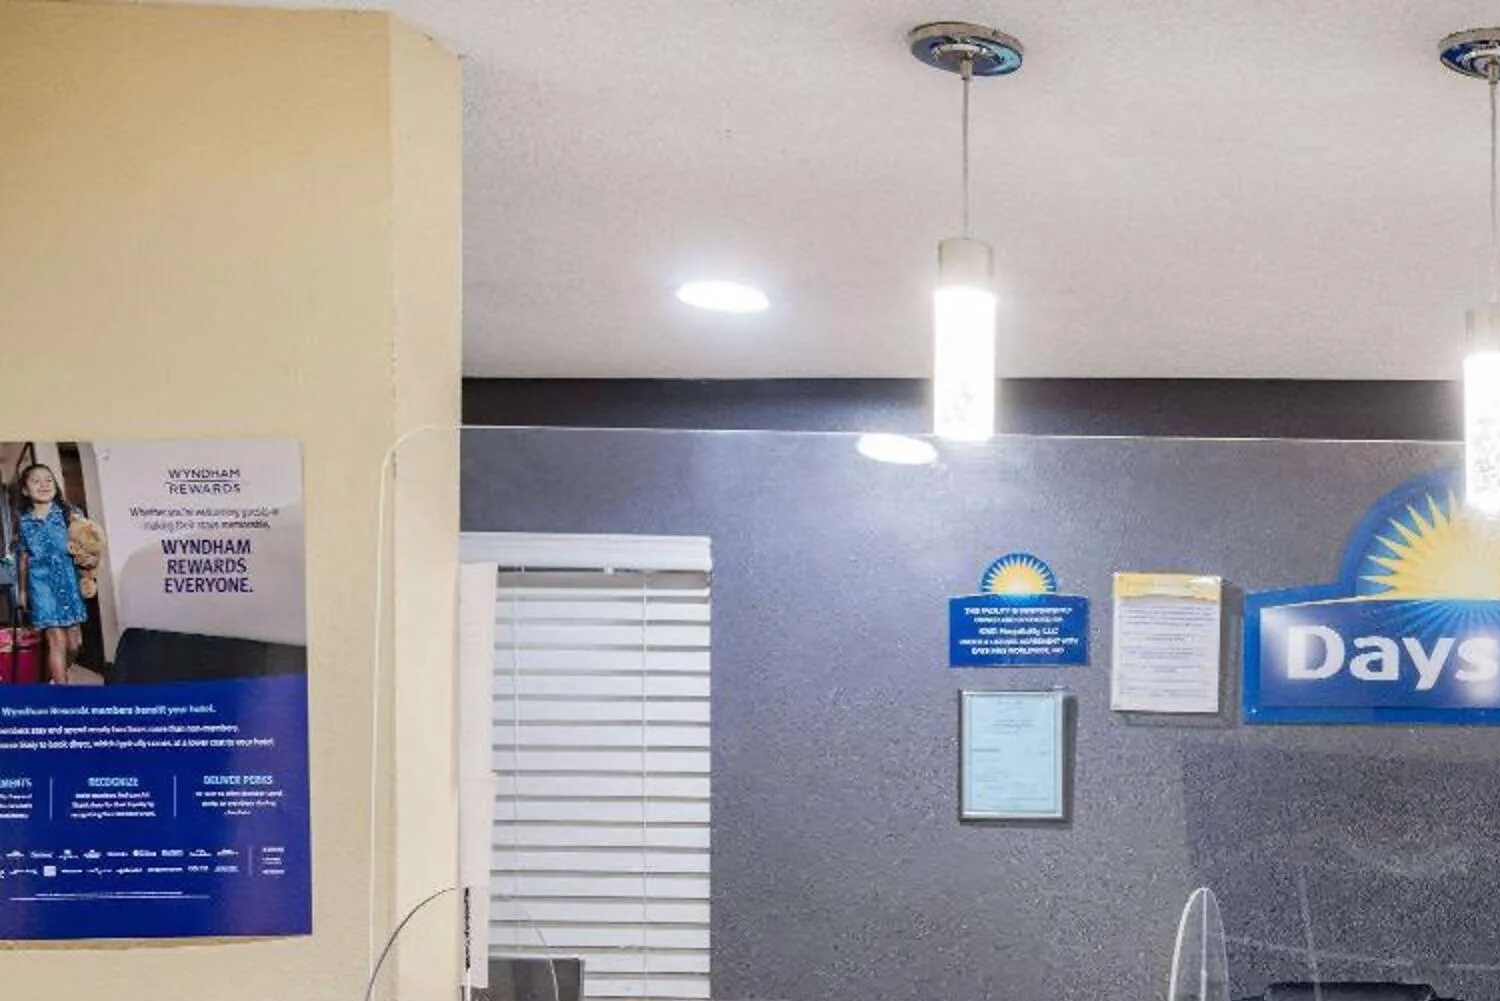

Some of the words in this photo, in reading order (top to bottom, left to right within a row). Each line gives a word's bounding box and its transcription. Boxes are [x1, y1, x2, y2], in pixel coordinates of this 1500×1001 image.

[168, 468, 241, 479] WYNDHAM
[168, 483, 241, 495] REWARDS
[161, 538, 252, 555] WYNDHAM
[167, 557, 247, 575] REWARDS
[164, 576, 254, 594] EVERYONE.
[1287, 624, 1499, 690] Days
